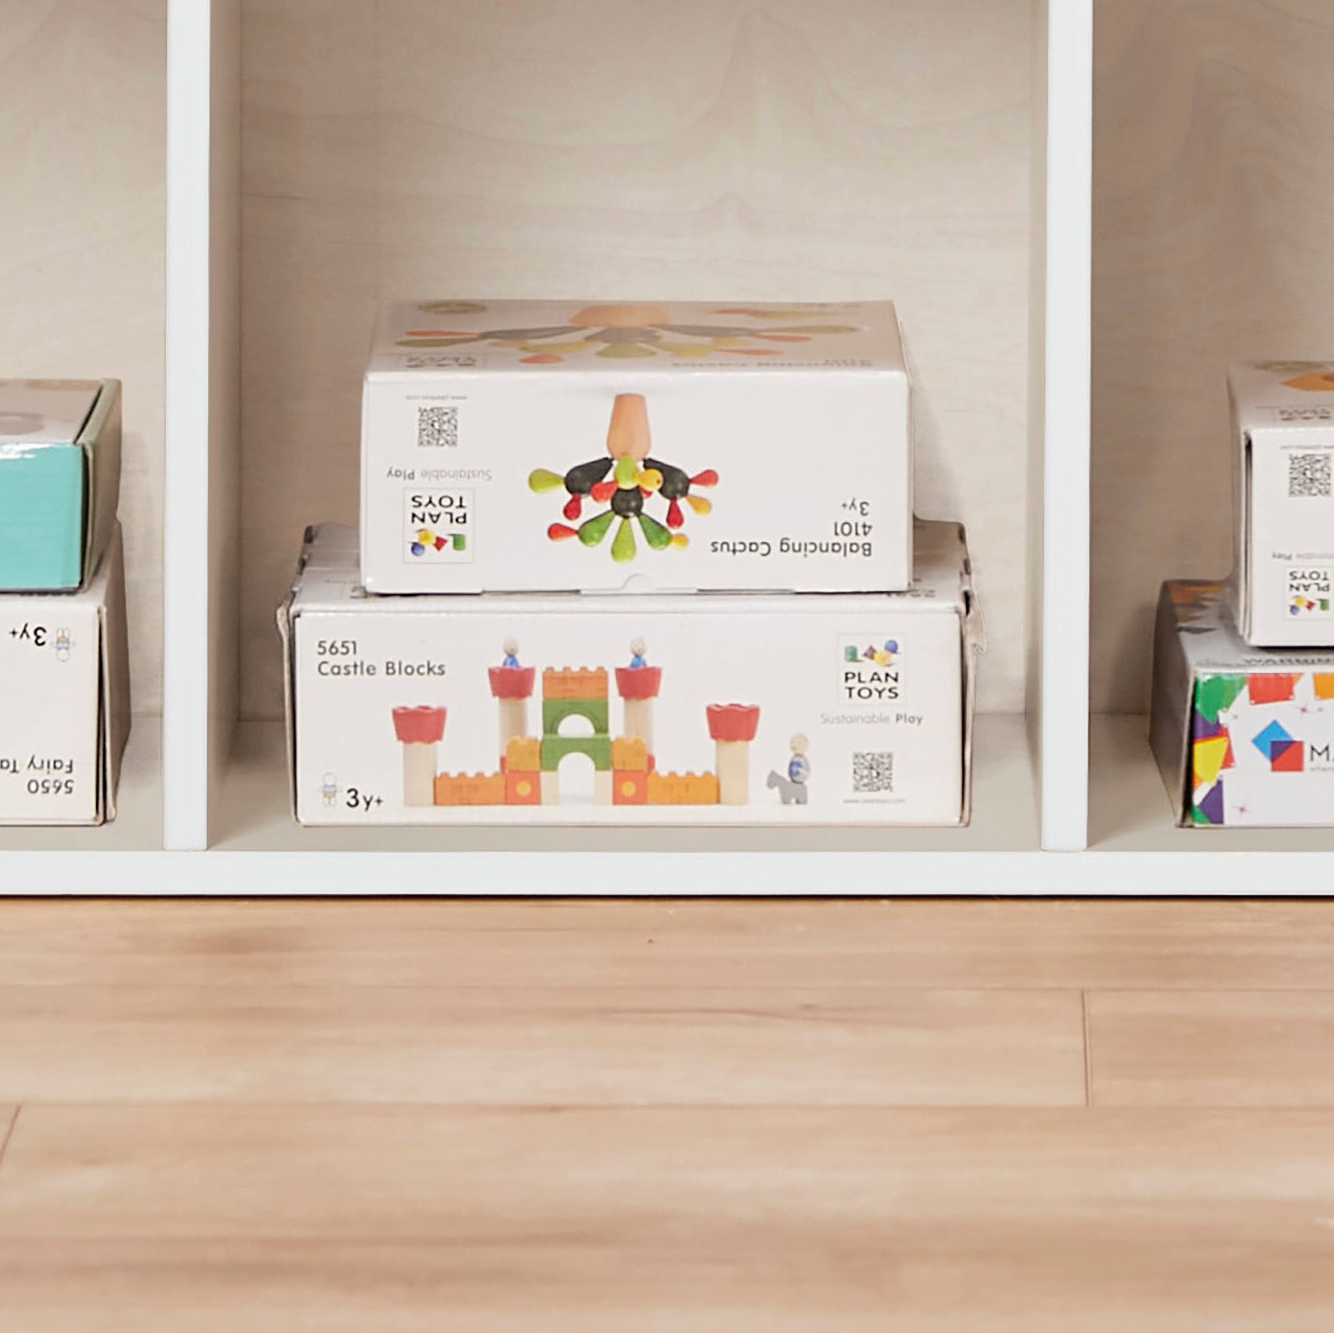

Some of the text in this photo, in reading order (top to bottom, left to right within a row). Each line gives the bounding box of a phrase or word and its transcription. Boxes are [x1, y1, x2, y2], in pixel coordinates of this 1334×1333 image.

[387, 466, 492, 481] Sustainable Play
[411, 495, 466, 508] TOYS
[842, 498, 870, 516] 3y+
[411, 512, 467, 524] PLAN
[834, 521, 872, 537] 4101
[711, 538, 872, 558] Balancing Cactus
[1289, 570, 1329, 581] TOYS
[1289, 583, 1330, 592] PLAN
[9, 623, 46, 647] 3y+
[317, 640, 357, 655] 5651
[317, 660, 446, 676] Castle Blocks
[844, 671, 899, 683] PLAN
[845, 686, 899, 699] TOYS
[820, 713, 923, 726] Sustainable Play
[27, 755, 73, 773] Fairy
[27, 779, 74, 794] 5650
[345, 788, 383, 811] 3y+
